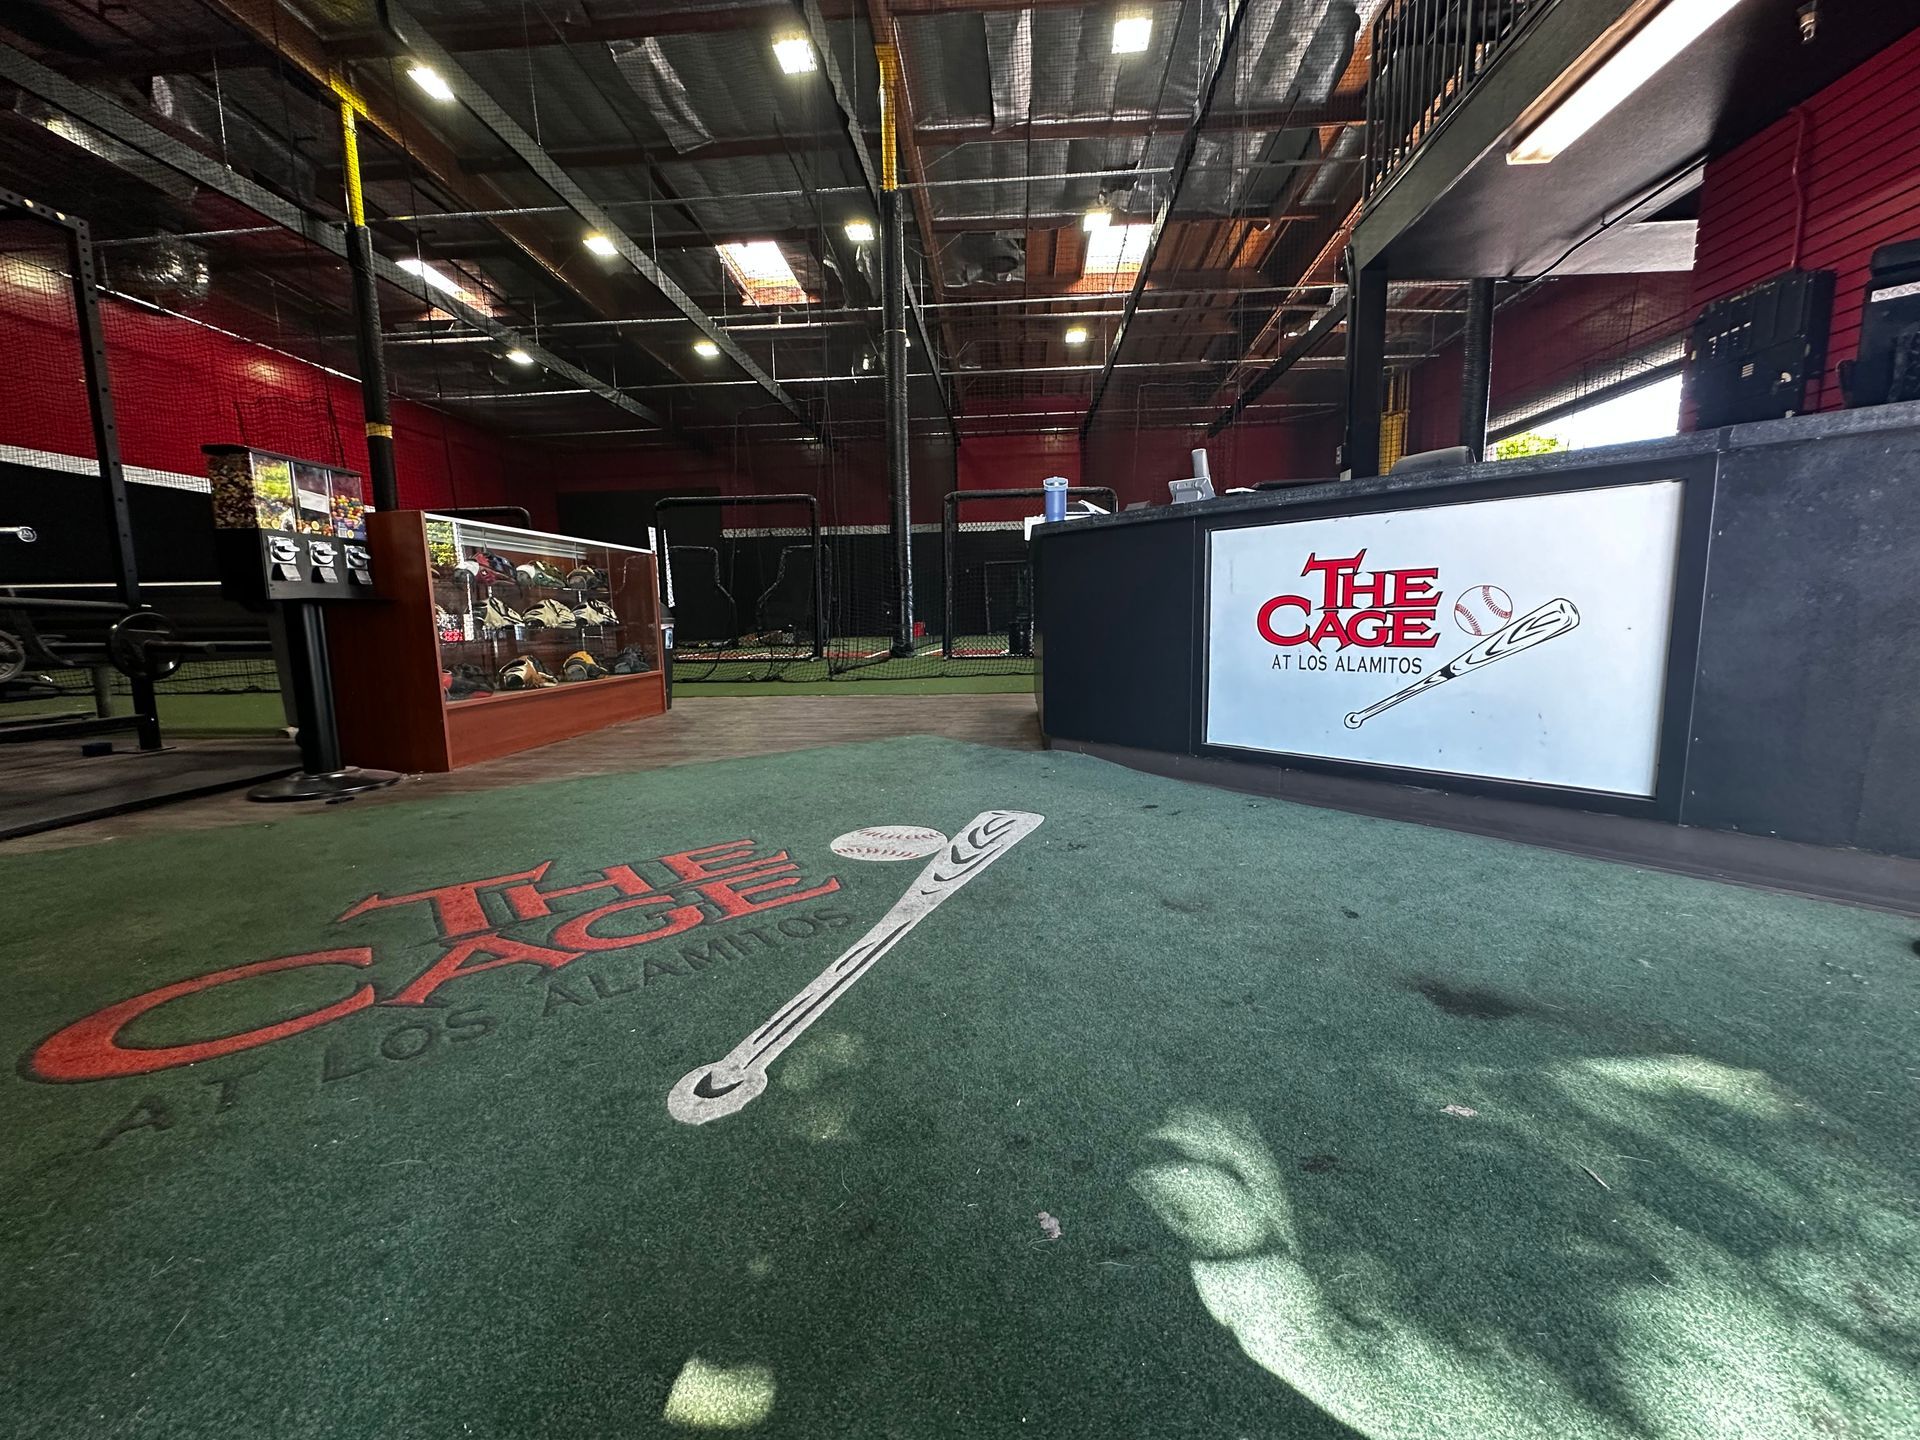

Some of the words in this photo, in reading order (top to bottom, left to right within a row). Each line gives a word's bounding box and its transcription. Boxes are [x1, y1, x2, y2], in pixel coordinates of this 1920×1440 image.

[1300, 548, 1443, 610] THE
[1257, 595, 1441, 652] CAGE
[1272, 655, 1291, 669] AT
[1299, 655, 1327, 670] LOS
[1335, 656, 1422, 674] ALAMITOS
[334, 839, 789, 948] THE
[16, 863, 841, 1084] CAGE
[45, 1063, 267, 1165] AT
[322, 1008, 497, 1083] LOS
[540, 906, 853, 1016] ALAMITOS
